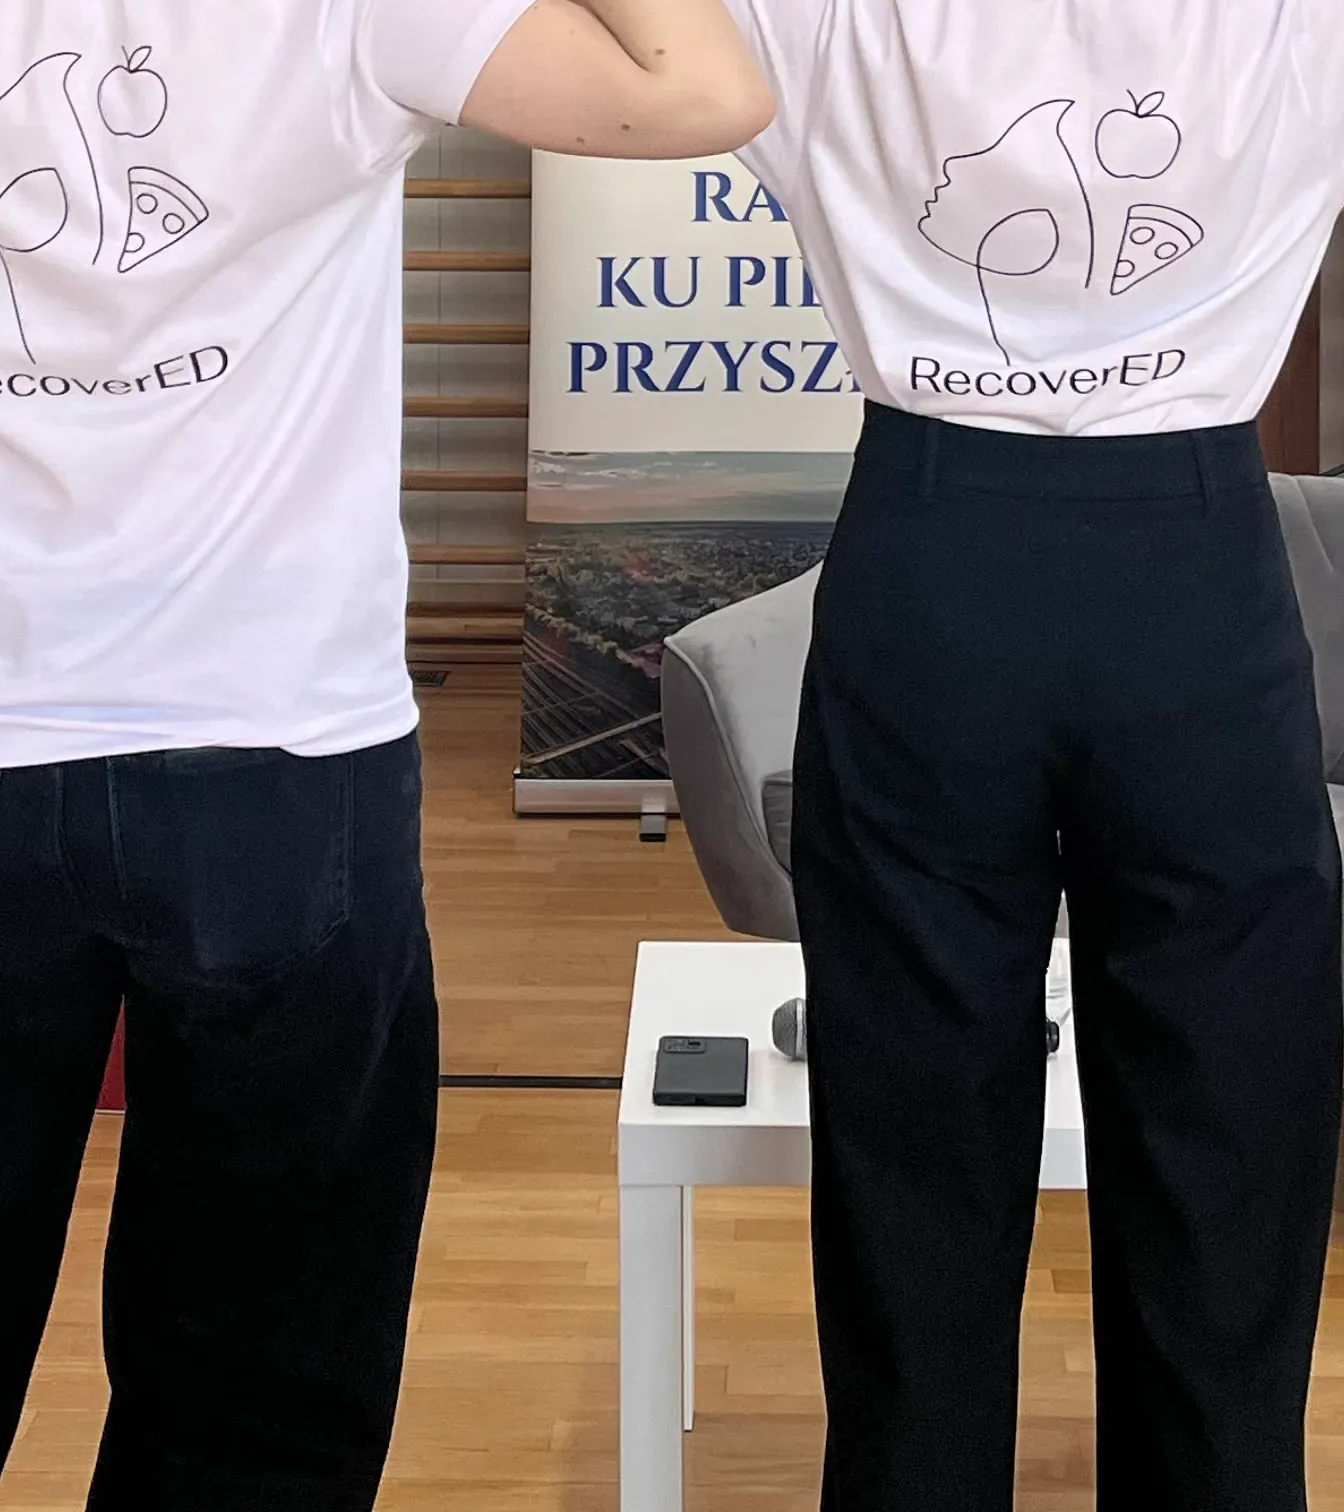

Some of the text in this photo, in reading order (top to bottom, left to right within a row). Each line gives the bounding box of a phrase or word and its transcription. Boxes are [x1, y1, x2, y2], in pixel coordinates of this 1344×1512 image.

[596, 256, 702, 308] KU
[565, 340, 862, 394] PRZYSZ
[910, 349, 1186, 397] RecoverED
